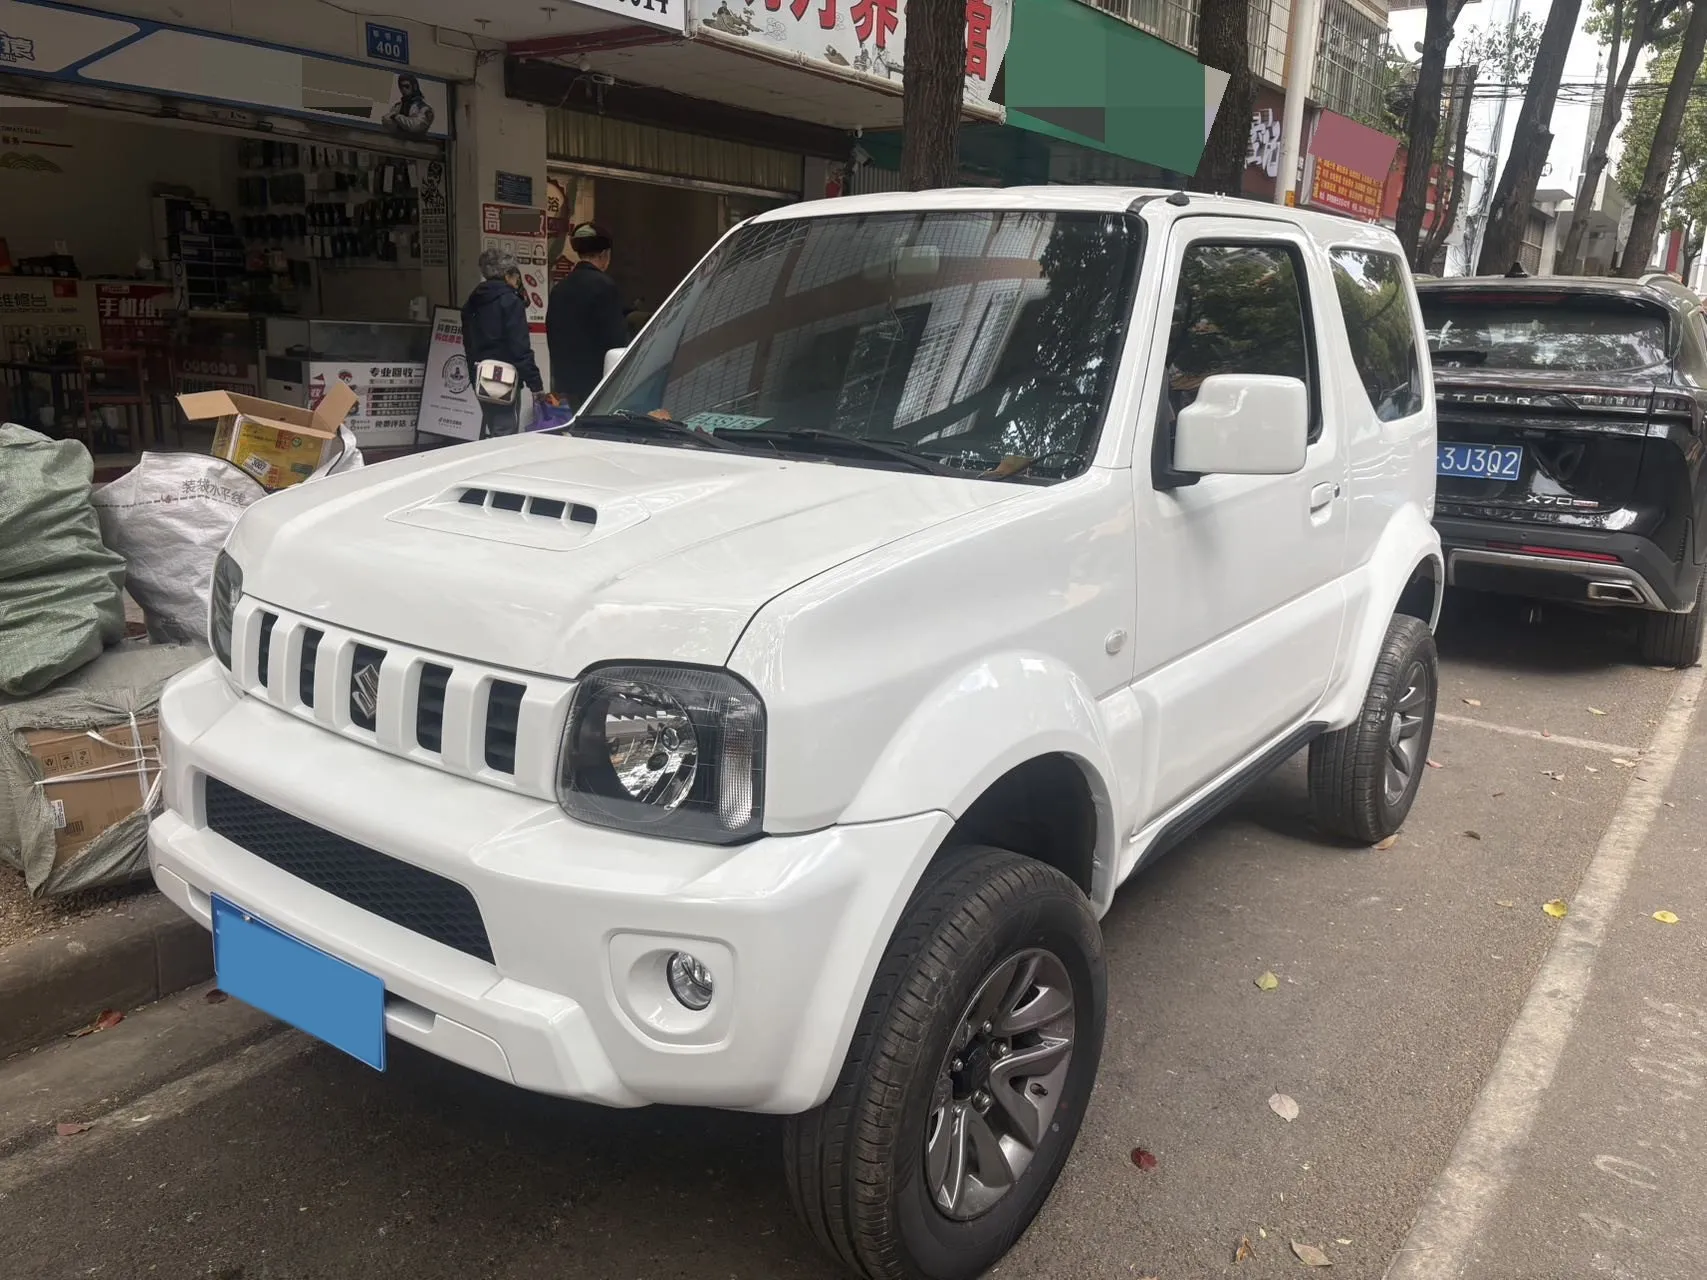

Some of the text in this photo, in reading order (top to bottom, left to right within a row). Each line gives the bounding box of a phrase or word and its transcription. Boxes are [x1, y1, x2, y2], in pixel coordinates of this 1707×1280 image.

[376, 40, 401, 58] 400
[182, 477, 247, 506] 装袋水平线
